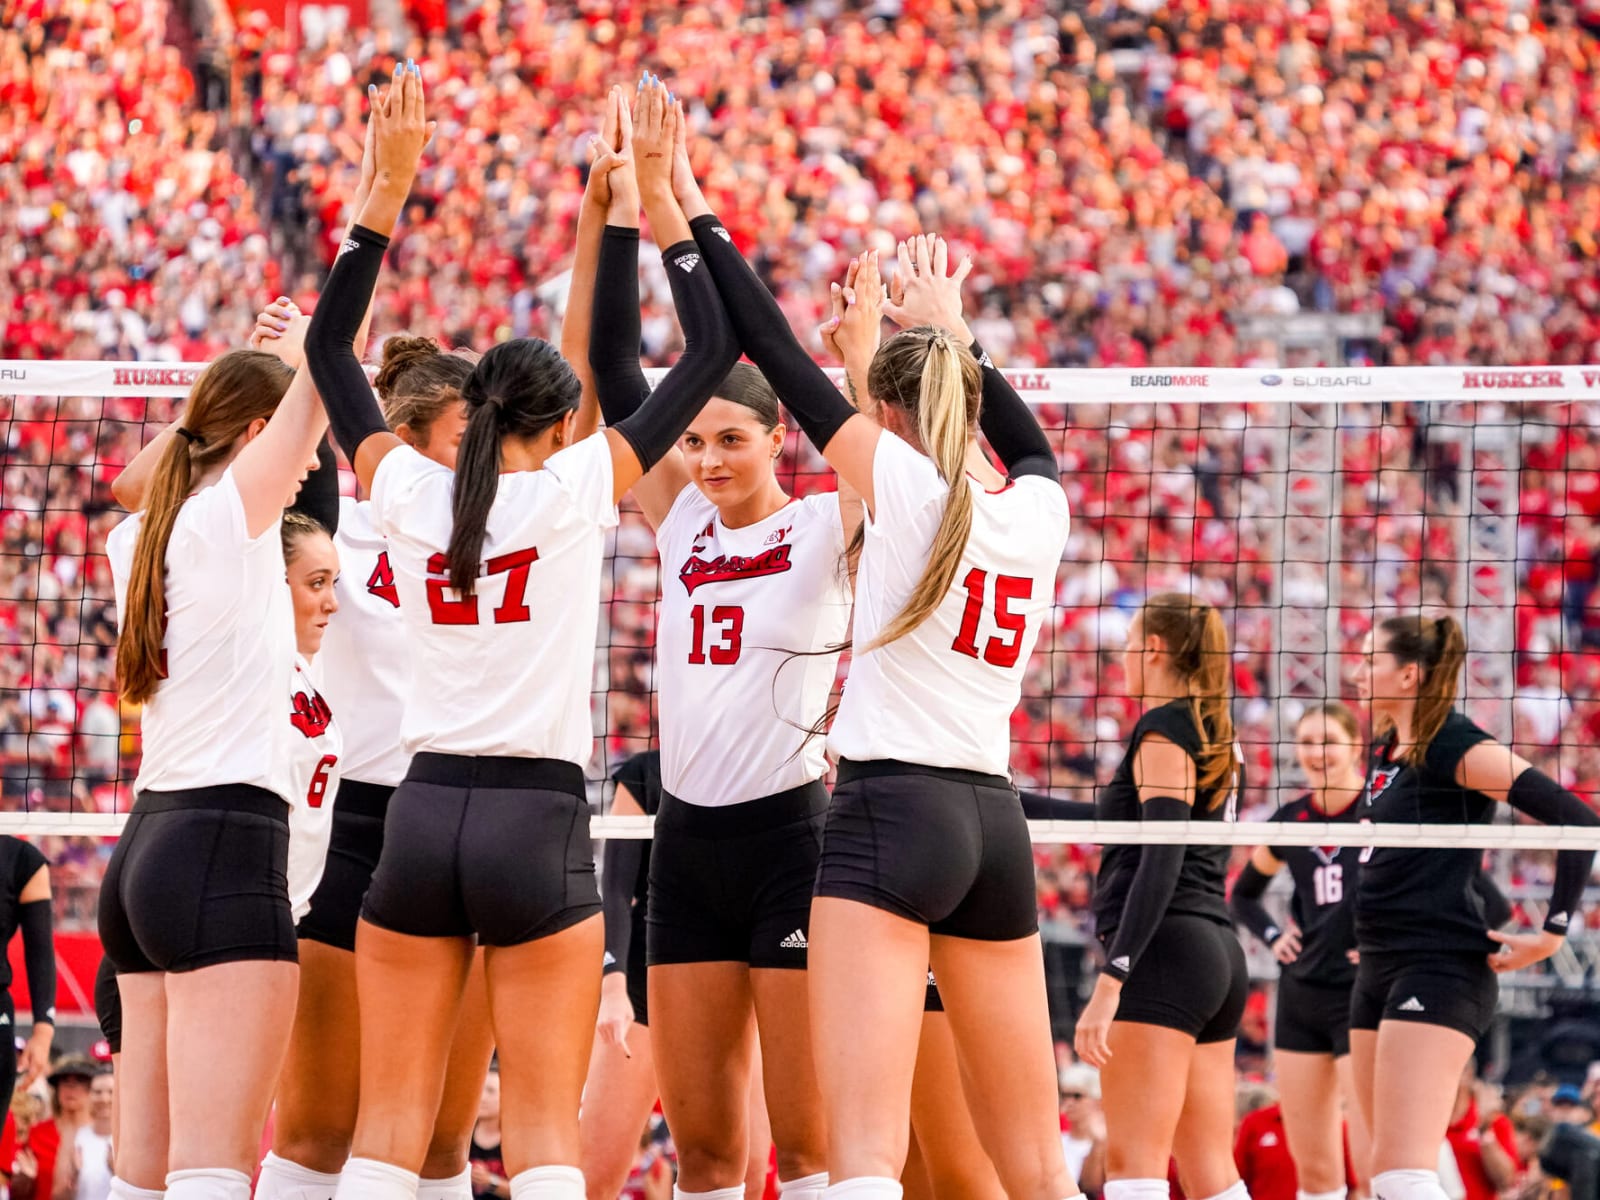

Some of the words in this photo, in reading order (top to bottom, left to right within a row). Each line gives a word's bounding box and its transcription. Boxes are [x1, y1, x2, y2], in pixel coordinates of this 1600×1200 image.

[112, 367, 201, 386] HUSKE
[1130, 374, 1209, 387] BEARDMORE
[1292, 375, 1372, 387] SUBARU
[1462, 371, 1565, 389] HUSKER
[425, 546, 540, 624] 27
[688, 604, 745, 665] 13
[951, 567, 1034, 668] 15
[307, 754, 338, 808] 6
[1312, 864, 1344, 906] 16
